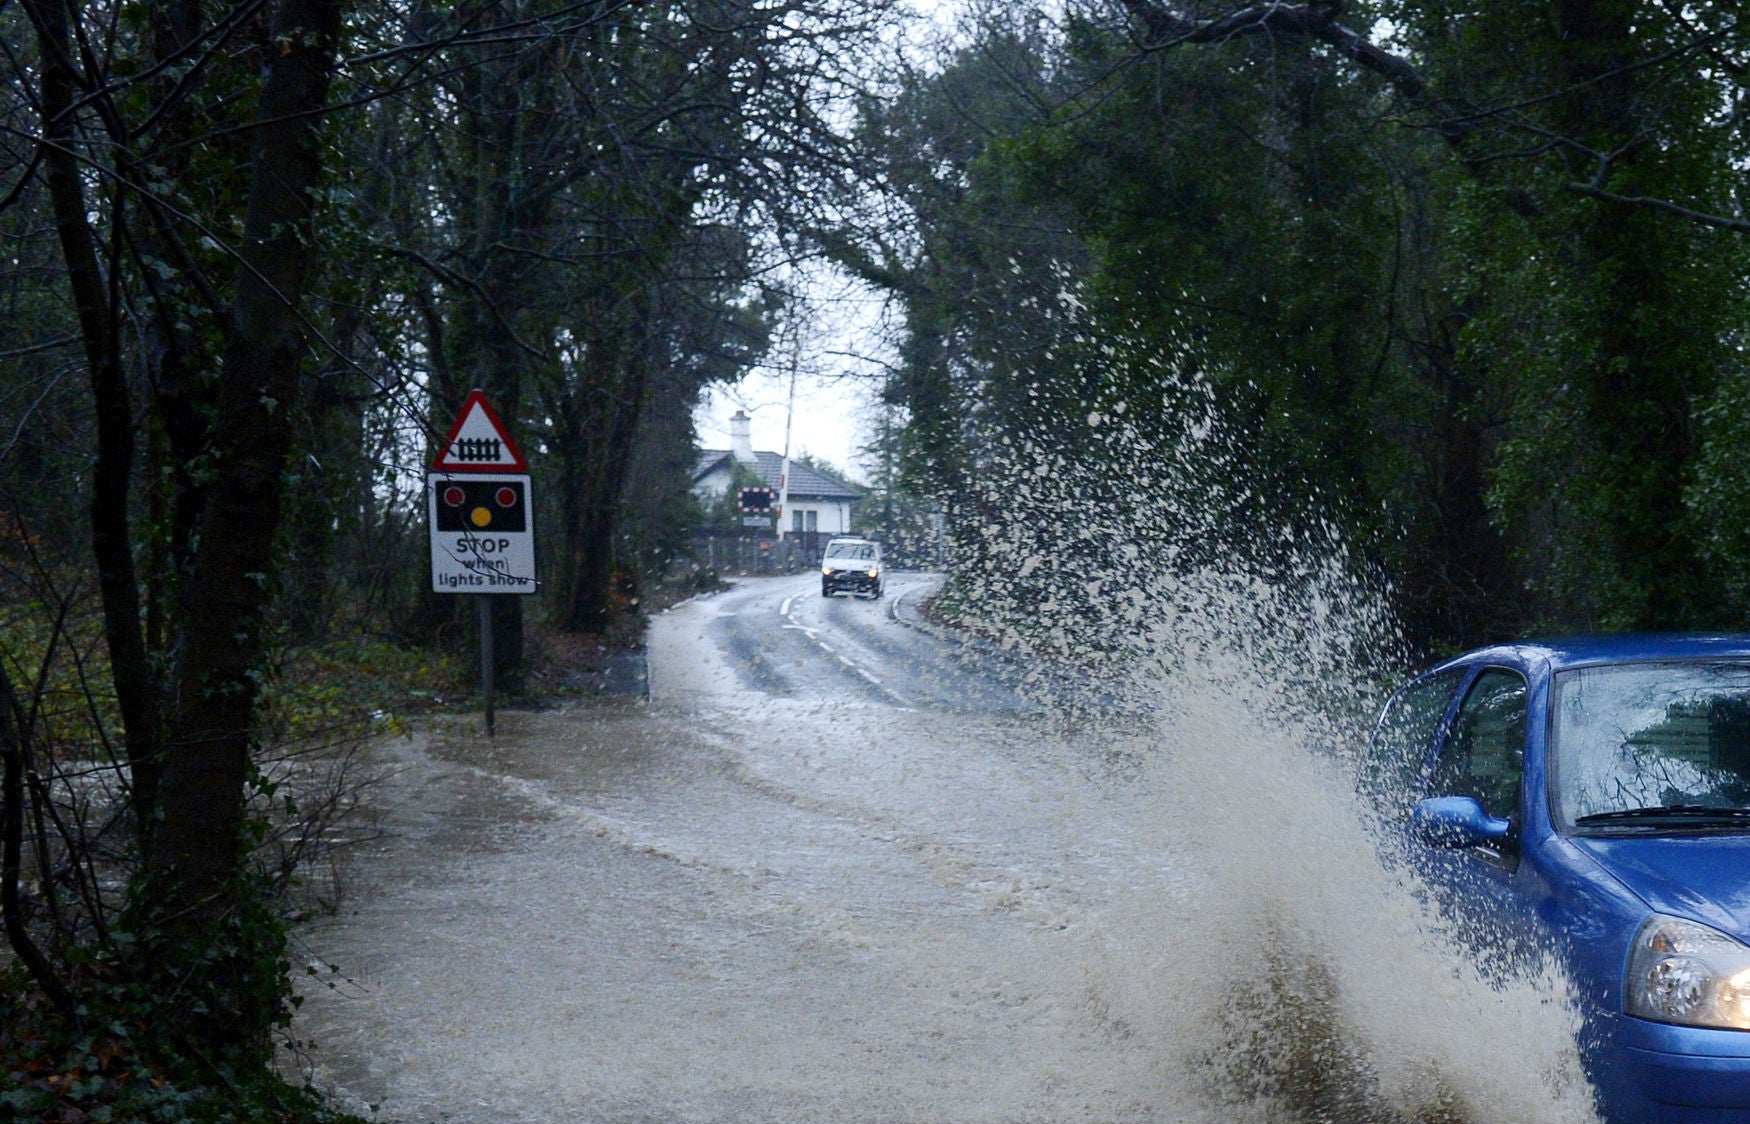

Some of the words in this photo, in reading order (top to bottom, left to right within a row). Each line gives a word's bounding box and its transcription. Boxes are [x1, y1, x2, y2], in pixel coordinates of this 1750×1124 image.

[456, 538, 510, 553] STOP
[463, 556, 504, 569] when
[439, 573, 483, 588] lights
[488, 573, 529, 586] show
